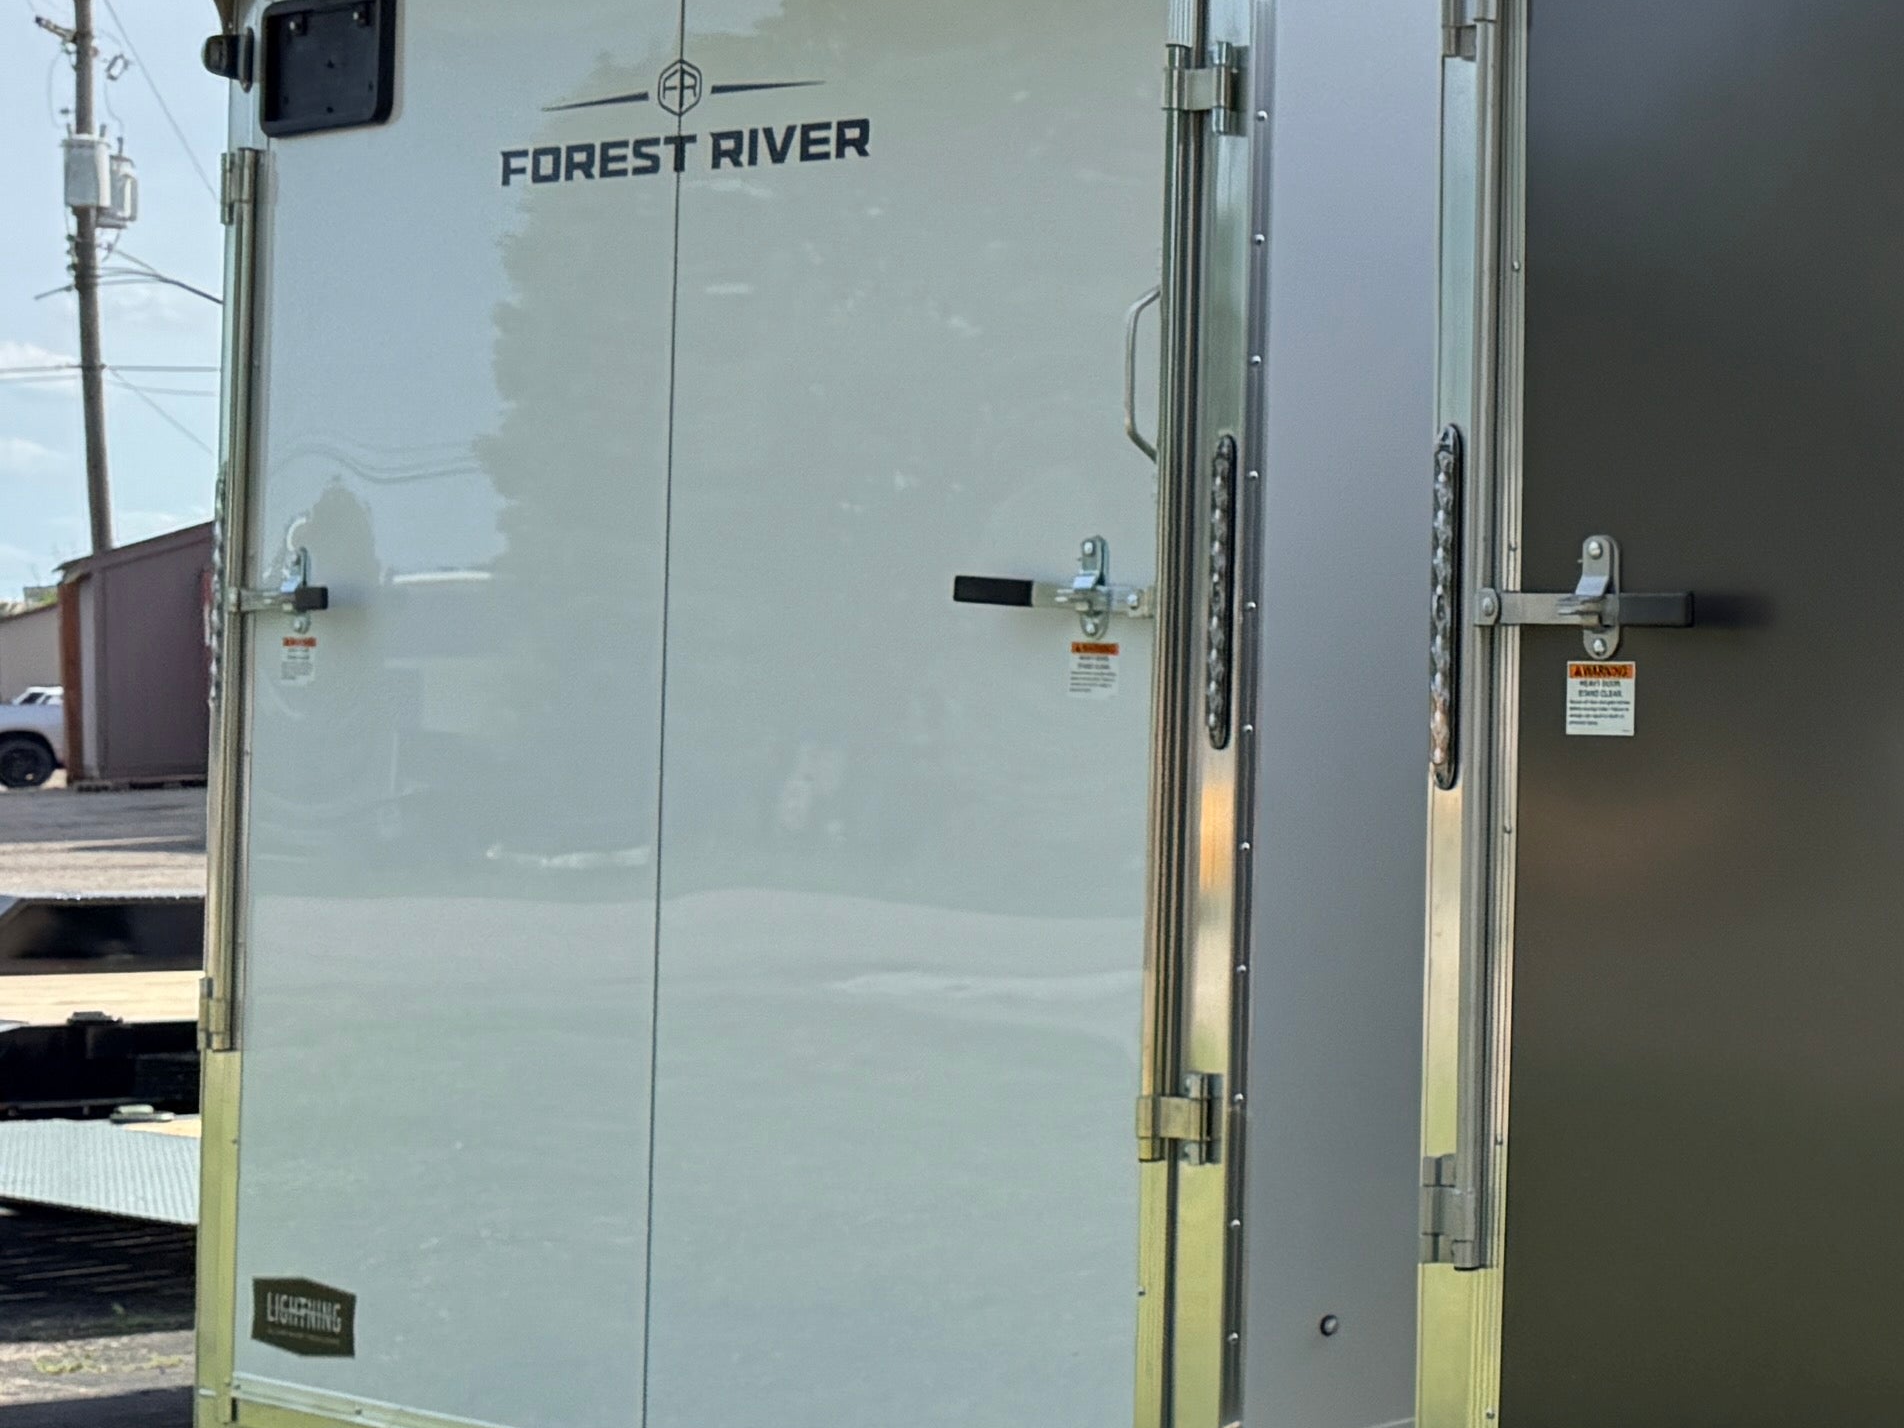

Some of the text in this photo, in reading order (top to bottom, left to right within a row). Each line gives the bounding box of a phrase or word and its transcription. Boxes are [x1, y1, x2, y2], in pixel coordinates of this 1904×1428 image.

[500, 118, 870, 187] FOREST RIVER
[267, 1291, 341, 1334] LIGHTNING
